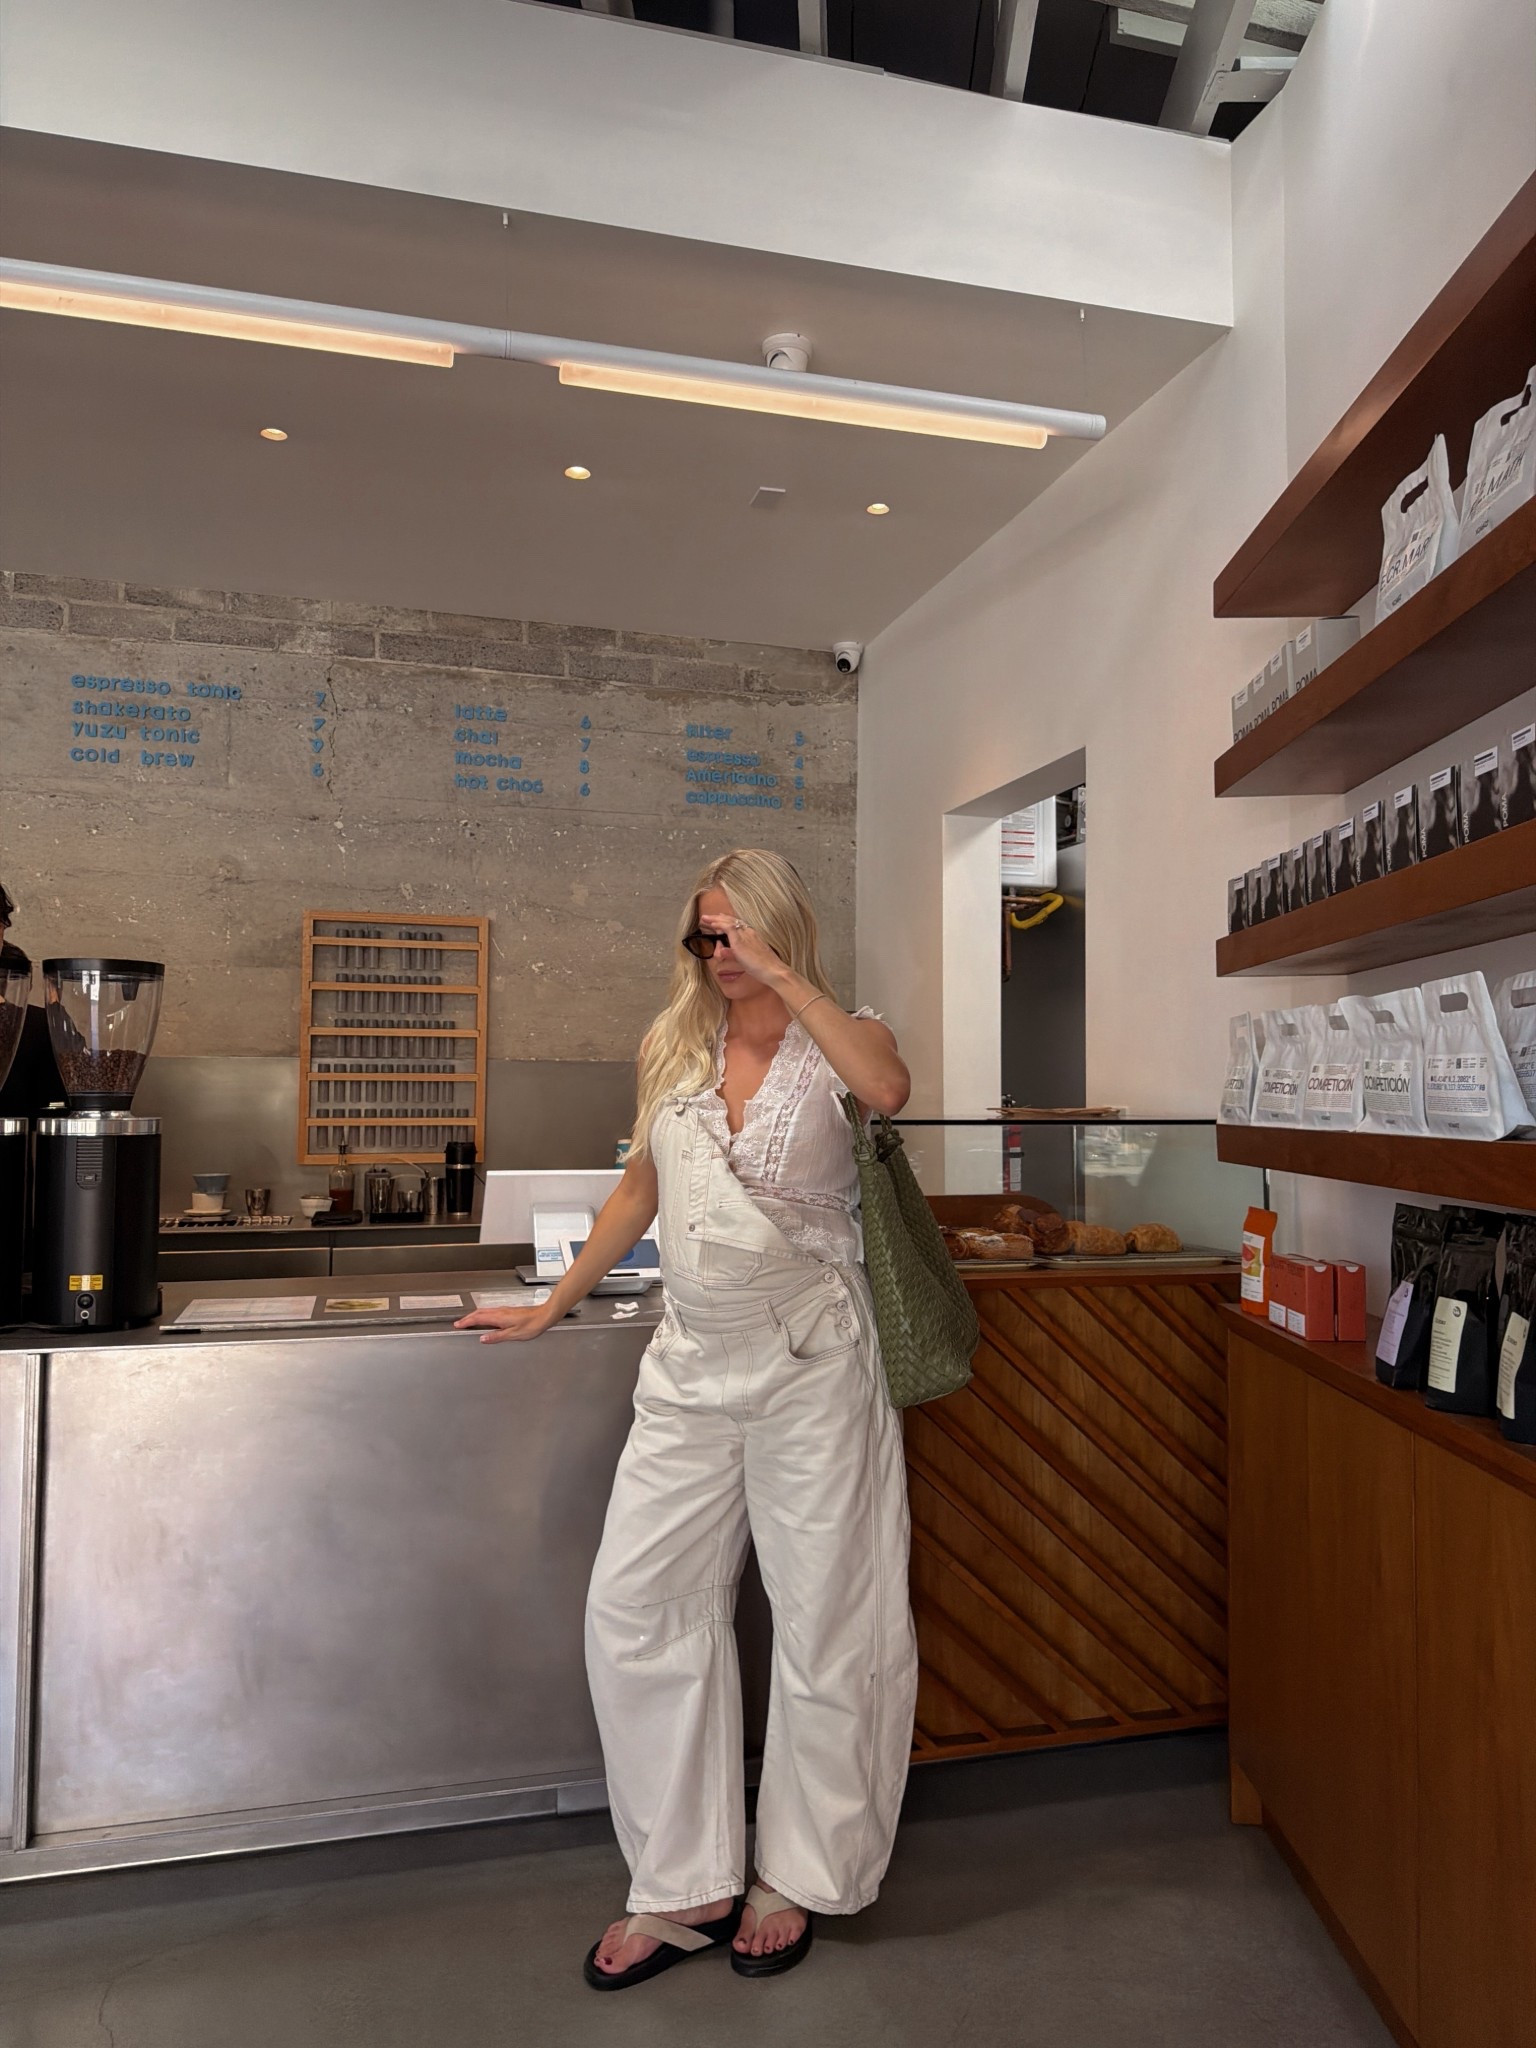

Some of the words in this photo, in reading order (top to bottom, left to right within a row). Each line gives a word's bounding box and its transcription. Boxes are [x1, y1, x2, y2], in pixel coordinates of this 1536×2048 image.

[70, 673, 171, 696] espresso
[187, 681, 243, 701] tonic
[314, 690, 326, 707] 7
[71, 699, 191, 722] shakerato
[313, 717, 326, 731] 7
[454, 704, 508, 723] latte
[580, 715, 592, 730] 6
[71, 720, 127, 740] yuzu
[140, 725, 200, 744] tonic
[311, 738, 324, 753] 9
[453, 728, 499, 746] chai
[579, 737, 591, 752] 7
[686, 723, 733, 740] filter
[70, 747, 120, 764] cold
[140, 749, 195, 768] brew
[312, 763, 324, 778] 6
[454, 751, 522, 770] mocha
[579, 759, 590, 774] 8
[686, 748, 761, 767] espresso
[454, 773, 488, 790] hot
[496, 777, 544, 794] choc
[579, 782, 591, 797] 6
[686, 767, 778, 788] Americano
[686, 791, 782, 809] cappuccino
[1501, 791, 1509, 828] POMA
[1463, 809, 1471, 843] POMA
[1420, 826, 1428, 858] POMA
